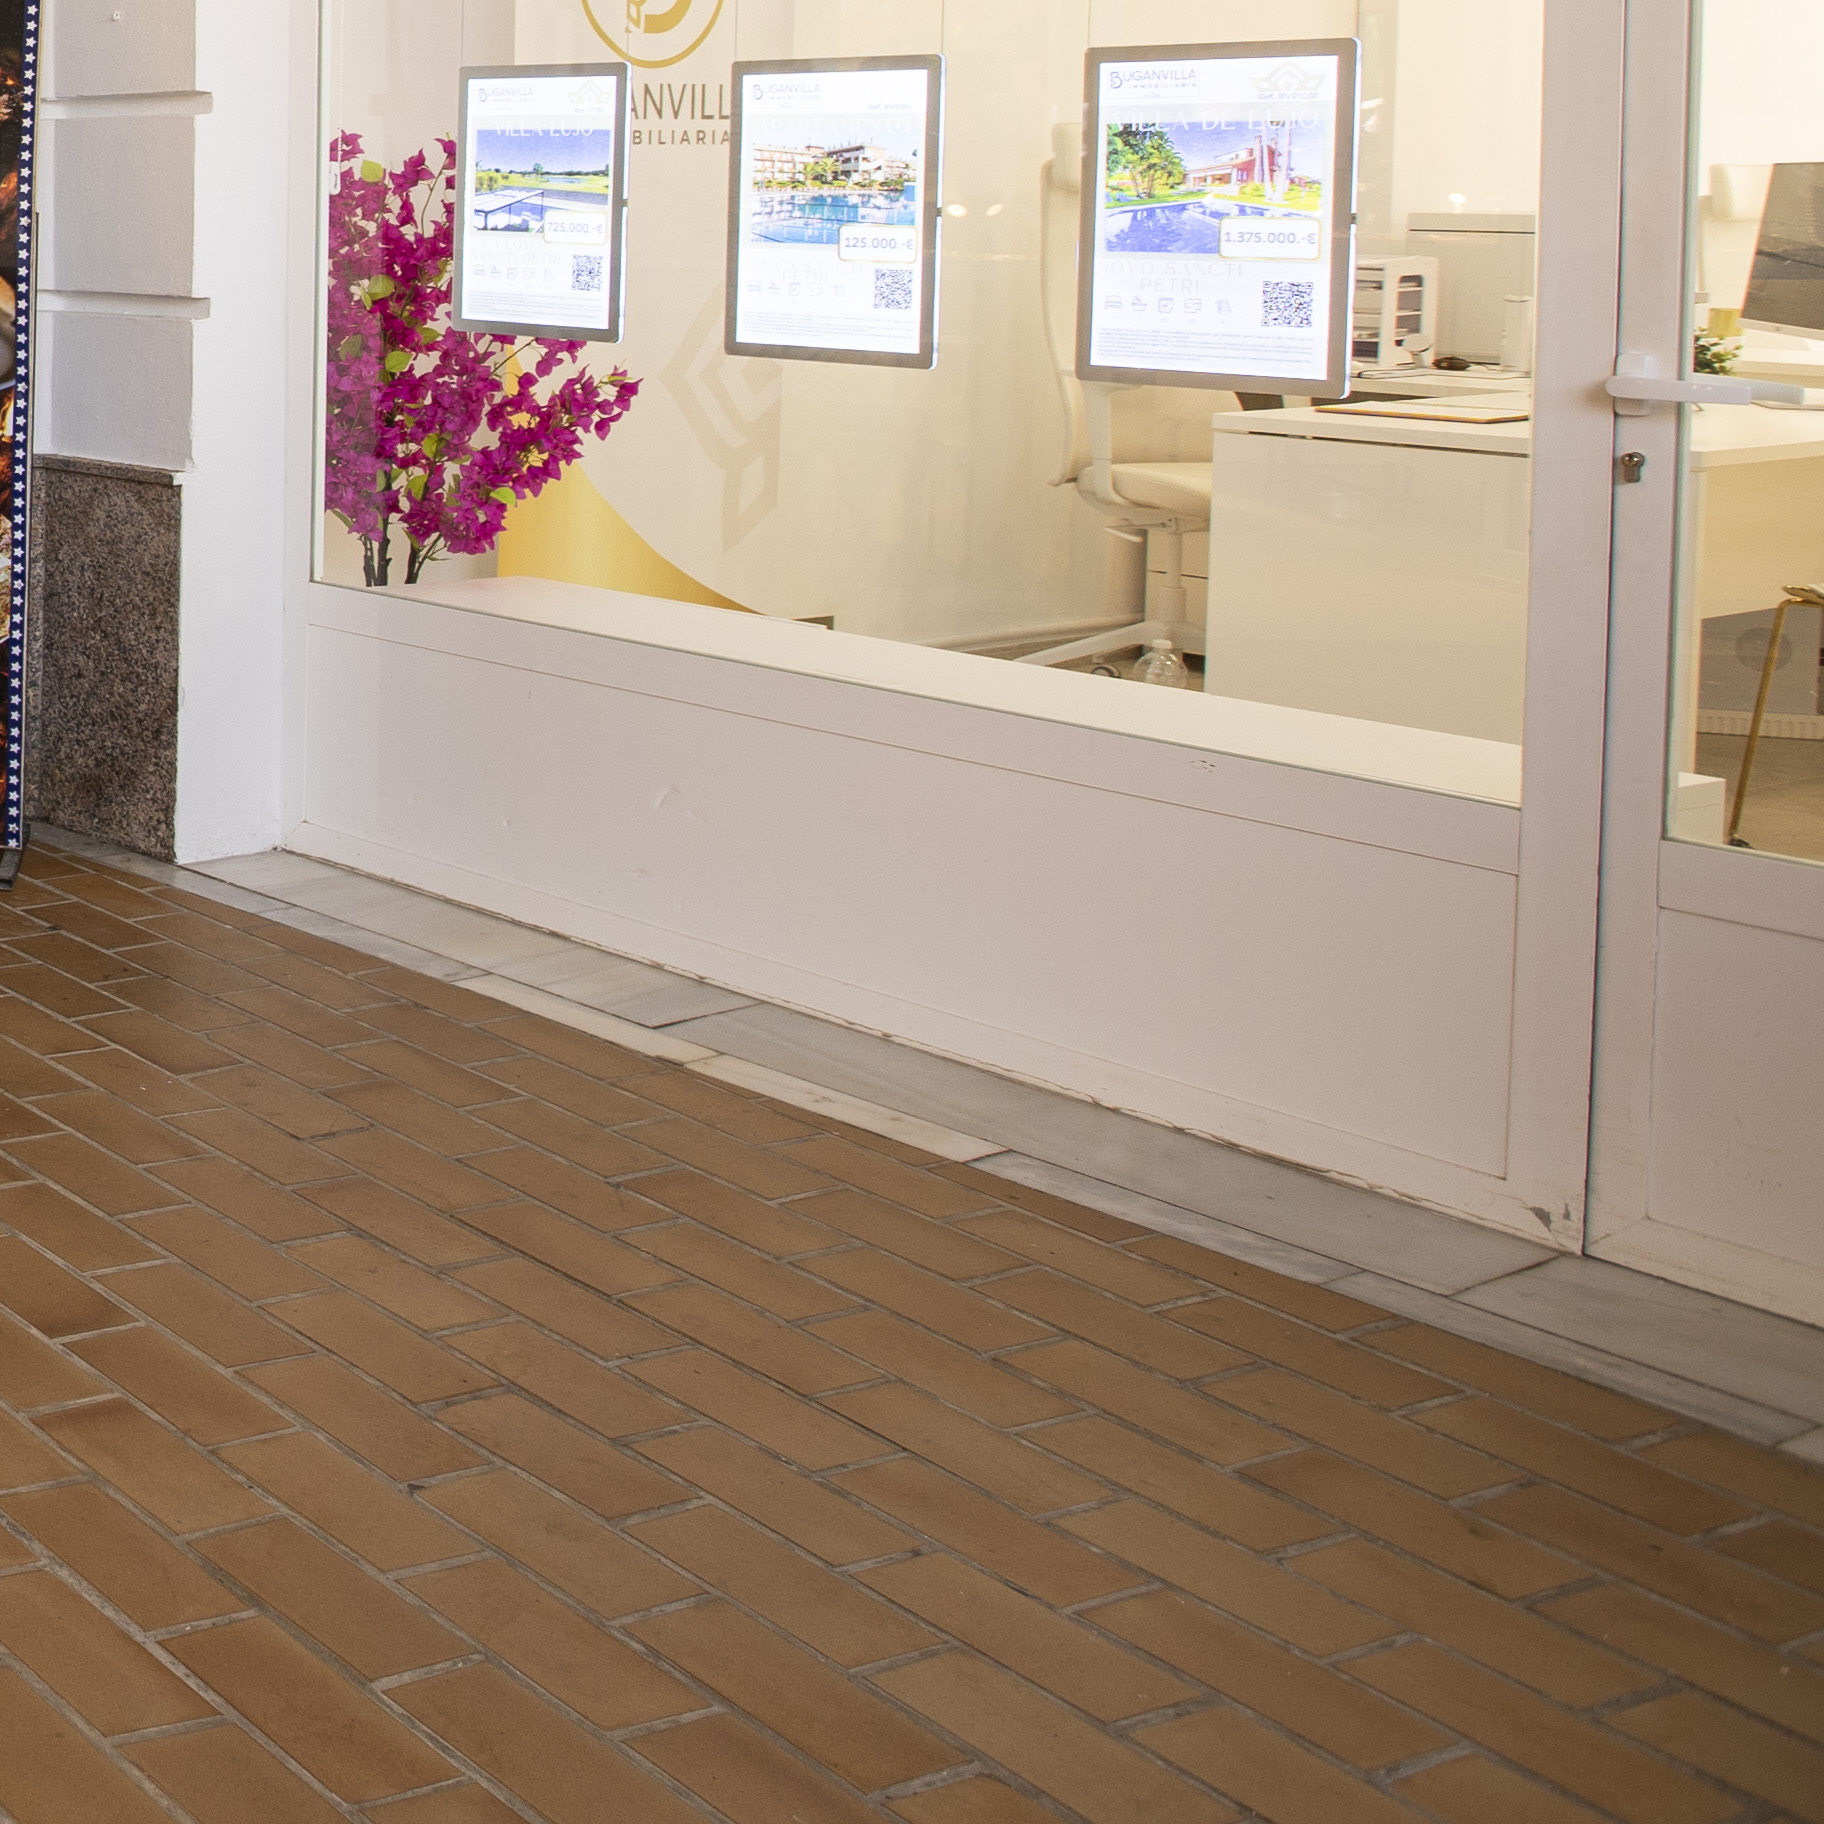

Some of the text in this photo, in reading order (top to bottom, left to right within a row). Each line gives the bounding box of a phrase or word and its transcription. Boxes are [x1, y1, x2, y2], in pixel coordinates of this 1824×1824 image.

[1109, 68, 1197, 91] BUGANVILLA
[1110, 107, 1320, 132] VILLA DE LUJO
[546, 221, 604, 235] 725.000.-€
[844, 237, 915, 252] 125.000.-€
[1223, 231, 1318, 246] 1.375.000.-€
[1140, 277, 1201, 294] PETRI
